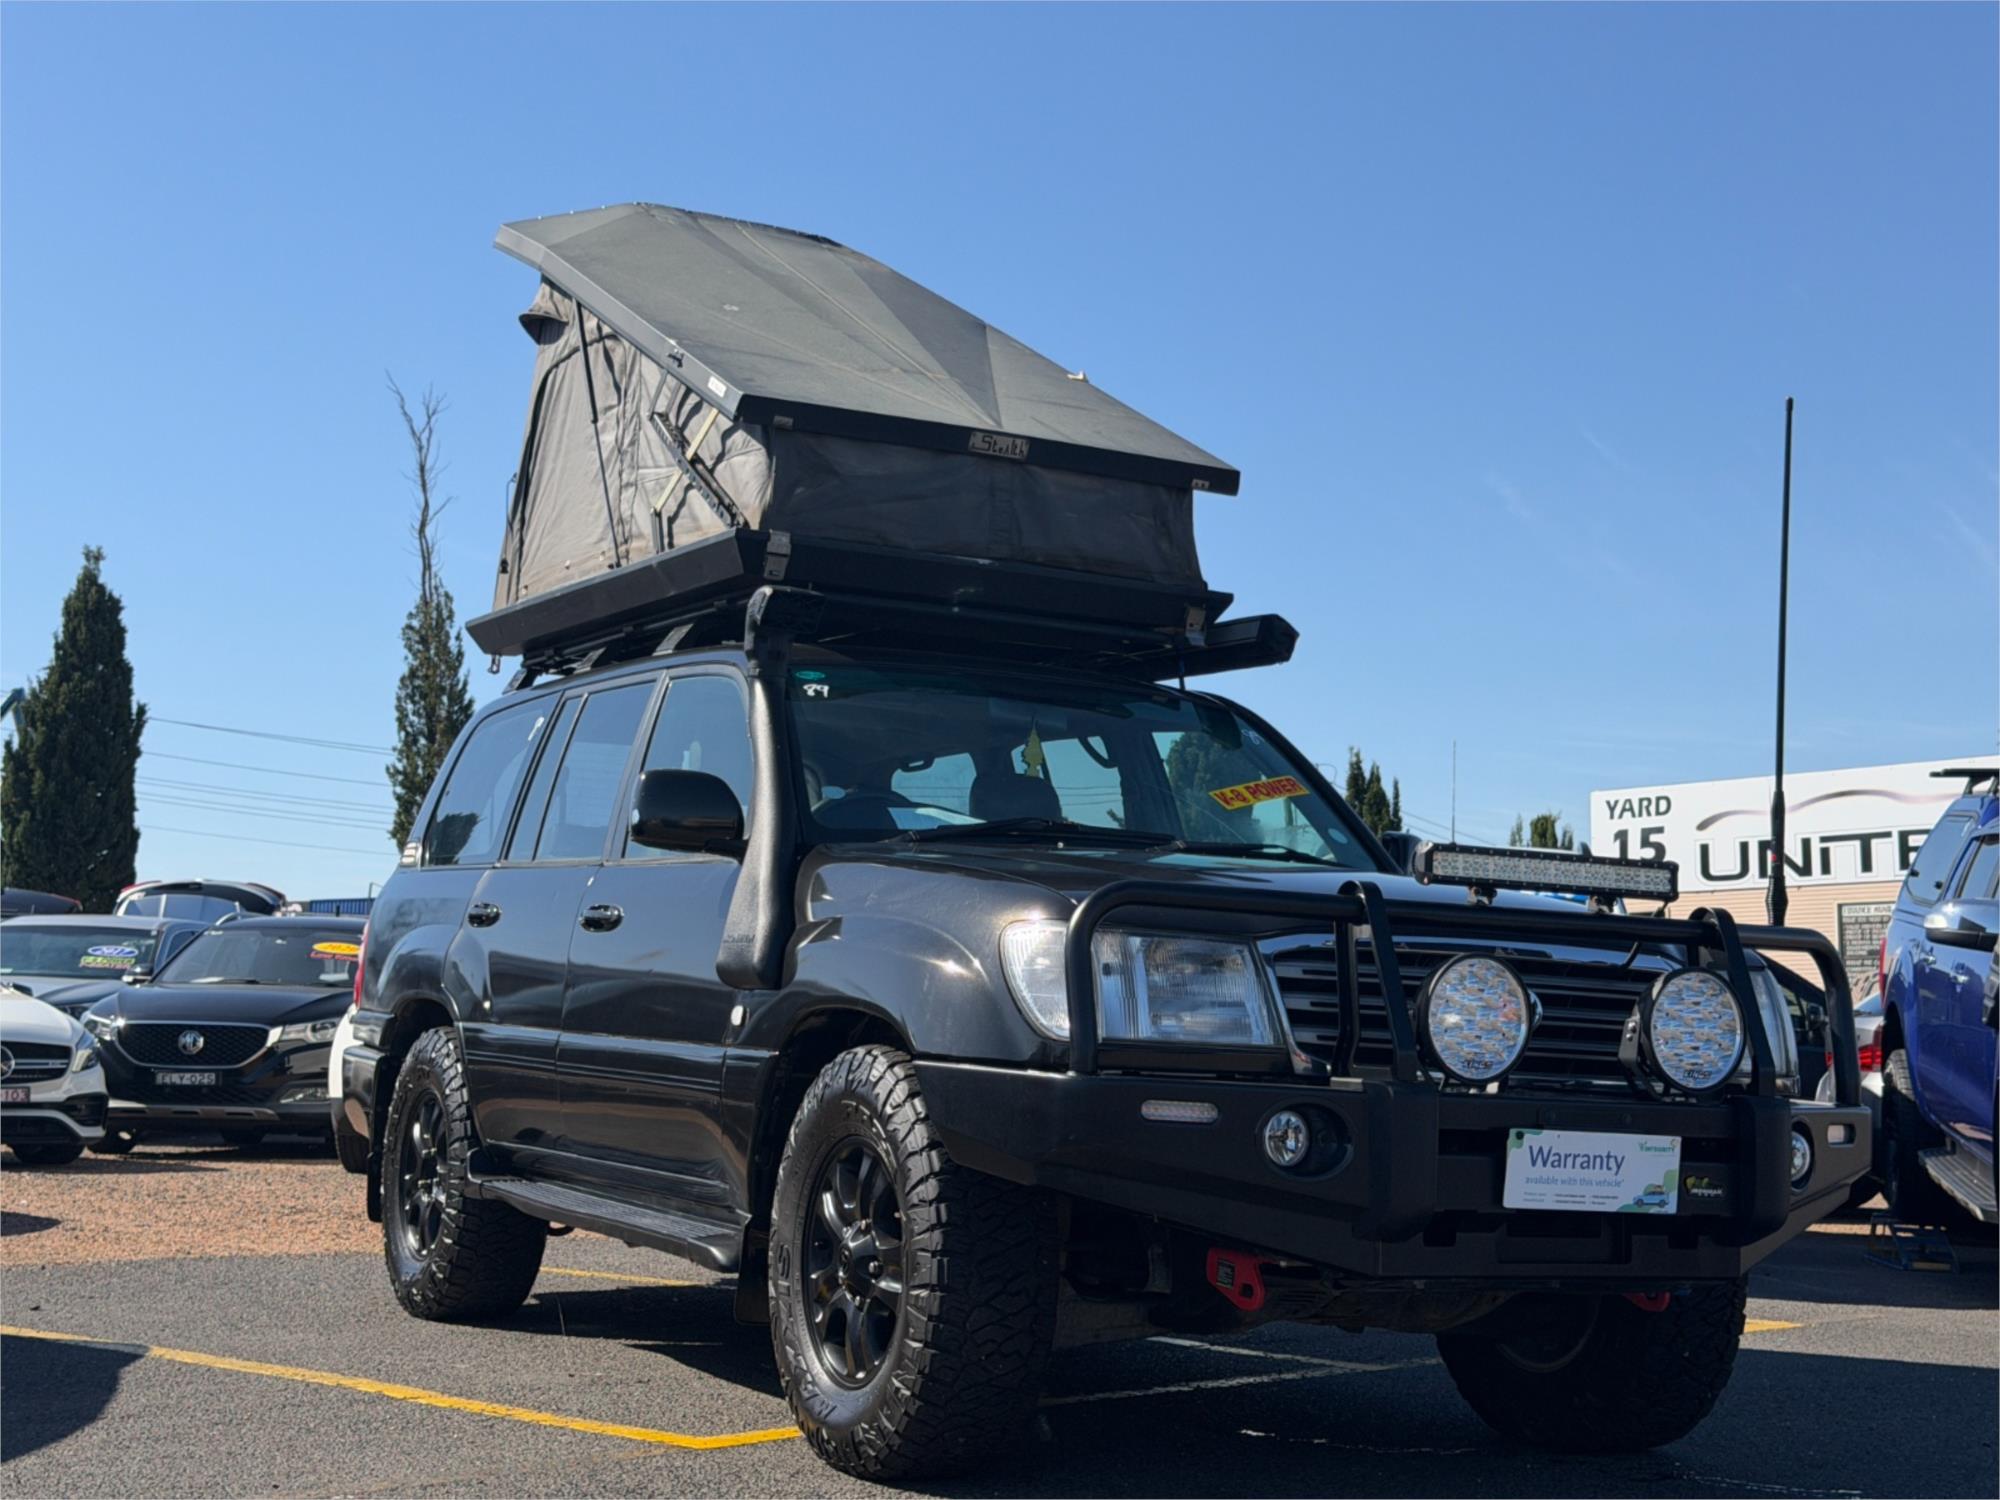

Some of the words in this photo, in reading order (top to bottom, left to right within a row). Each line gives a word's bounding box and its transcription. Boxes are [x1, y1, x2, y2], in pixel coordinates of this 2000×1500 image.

[1243, 777, 1298, 800] POWER
[1606, 795, 1672, 820] YARD
[1613, 826, 1667, 861] 15
[1528, 1144, 1626, 1176] Warranty
[1525, 1174, 1558, 1186] available
[1560, 1176, 1578, 1186] with
[1579, 1177, 1594, 1187] this
